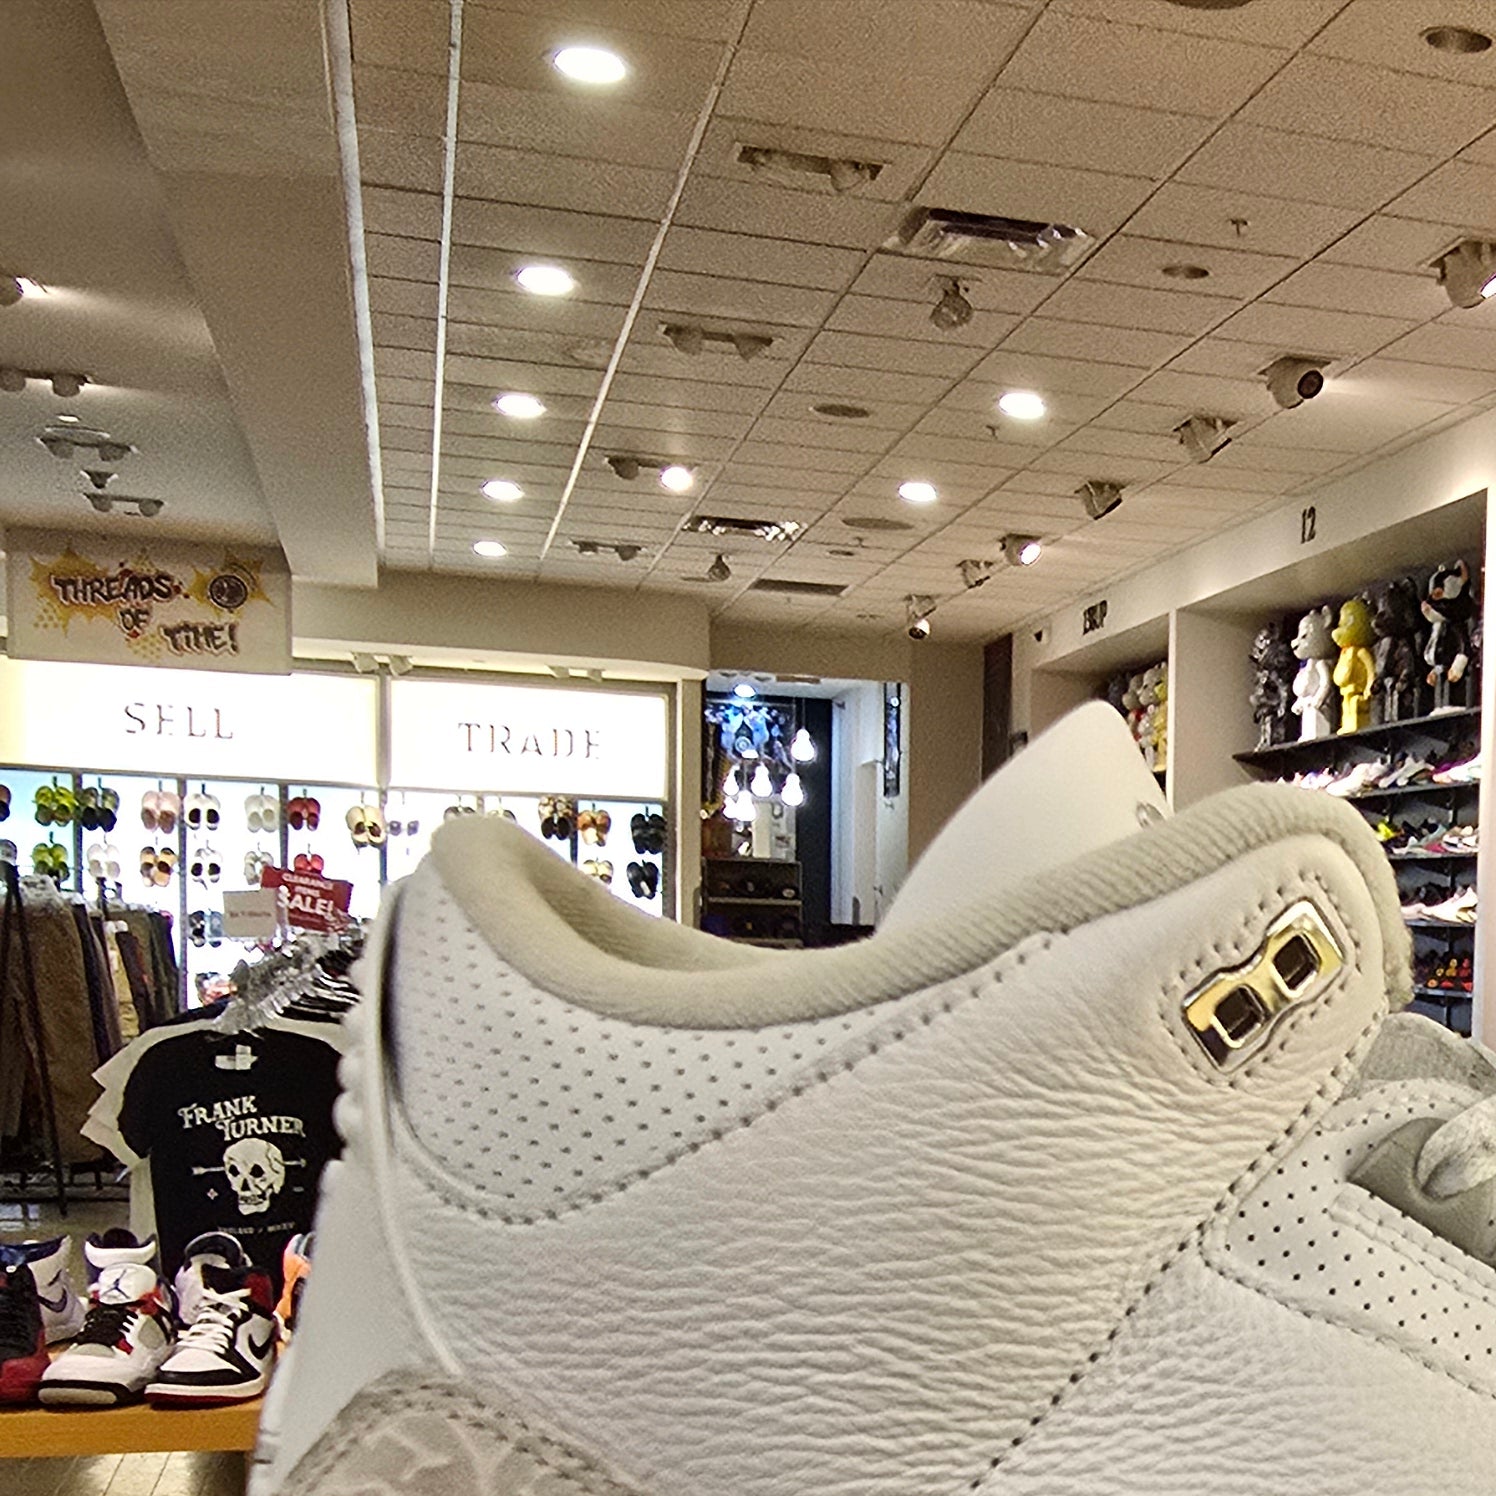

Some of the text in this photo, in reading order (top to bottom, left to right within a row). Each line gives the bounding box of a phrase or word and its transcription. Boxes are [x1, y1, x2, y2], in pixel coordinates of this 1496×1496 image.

[1300, 505, 1317, 544] 12
[50, 572, 176, 606] THREADS
[118, 607, 150, 633] OF
[124, 702, 234, 739] SELL
[457, 722, 602, 759] TRADE
[177, 1095, 258, 1129] FRANK
[215, 1115, 307, 1141] TURNER
